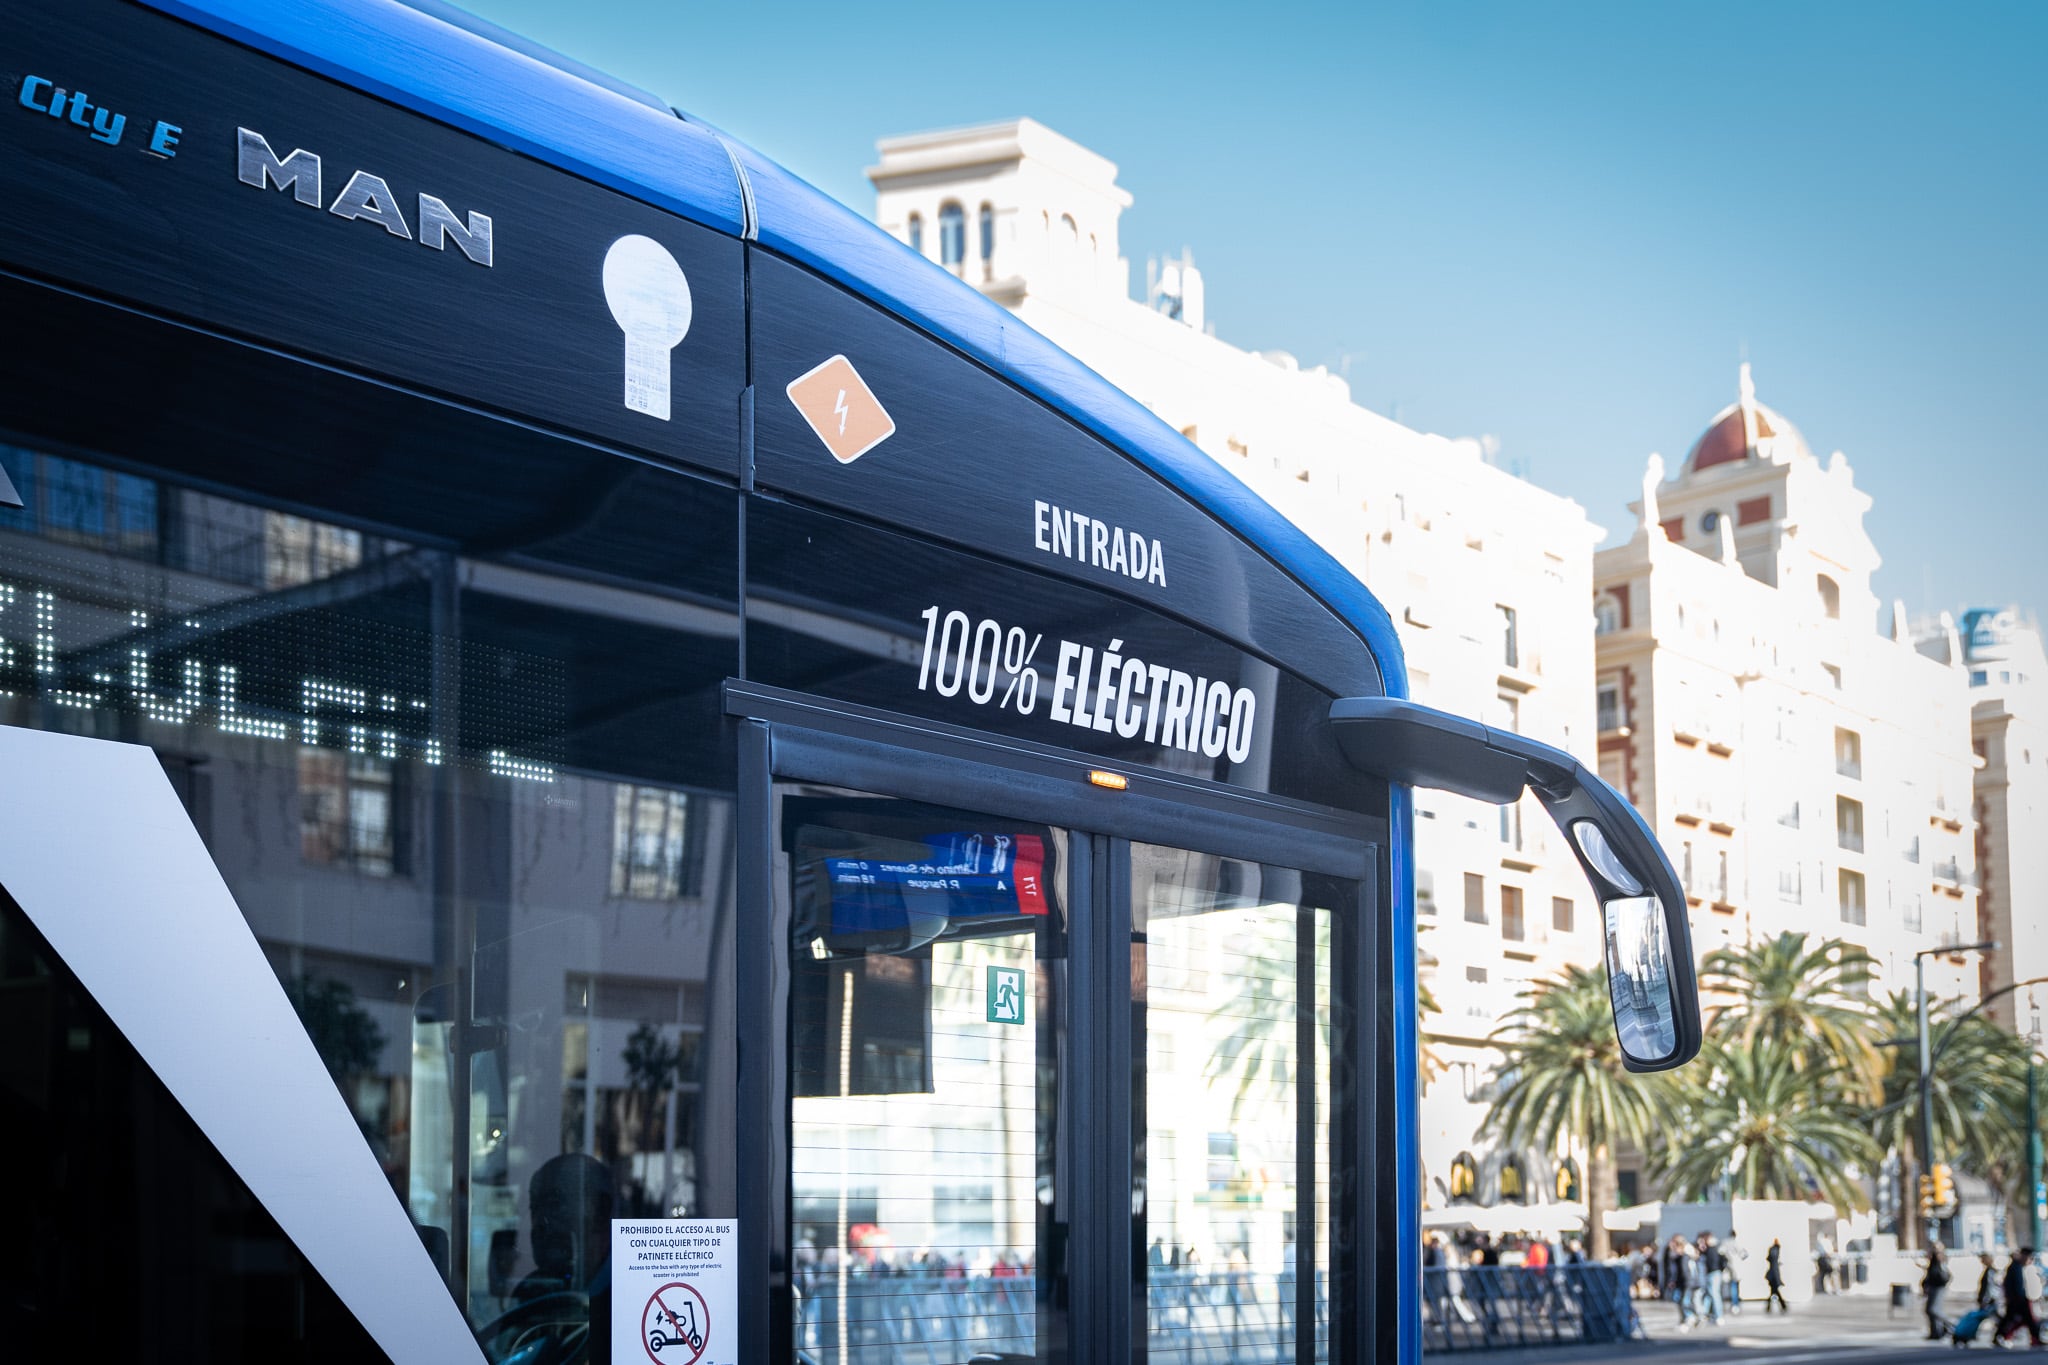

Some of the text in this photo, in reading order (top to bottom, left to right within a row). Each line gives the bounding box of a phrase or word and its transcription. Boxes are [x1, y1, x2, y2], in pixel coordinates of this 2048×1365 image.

[19, 74, 183, 158] City E
[237, 126, 493, 268] MAN
[1035, 499, 1167, 588] ENTRADA
[918, 605, 1256, 764] 100% ELÉCTRICO
[620, 1225, 730, 1234] PROHIBIDO EL ACCESO AL BUS
[630, 1238, 721, 1248] CON CUALQUIER TIPO DE
[638, 1250, 714, 1261] PATINETE ELÉCTRICO
